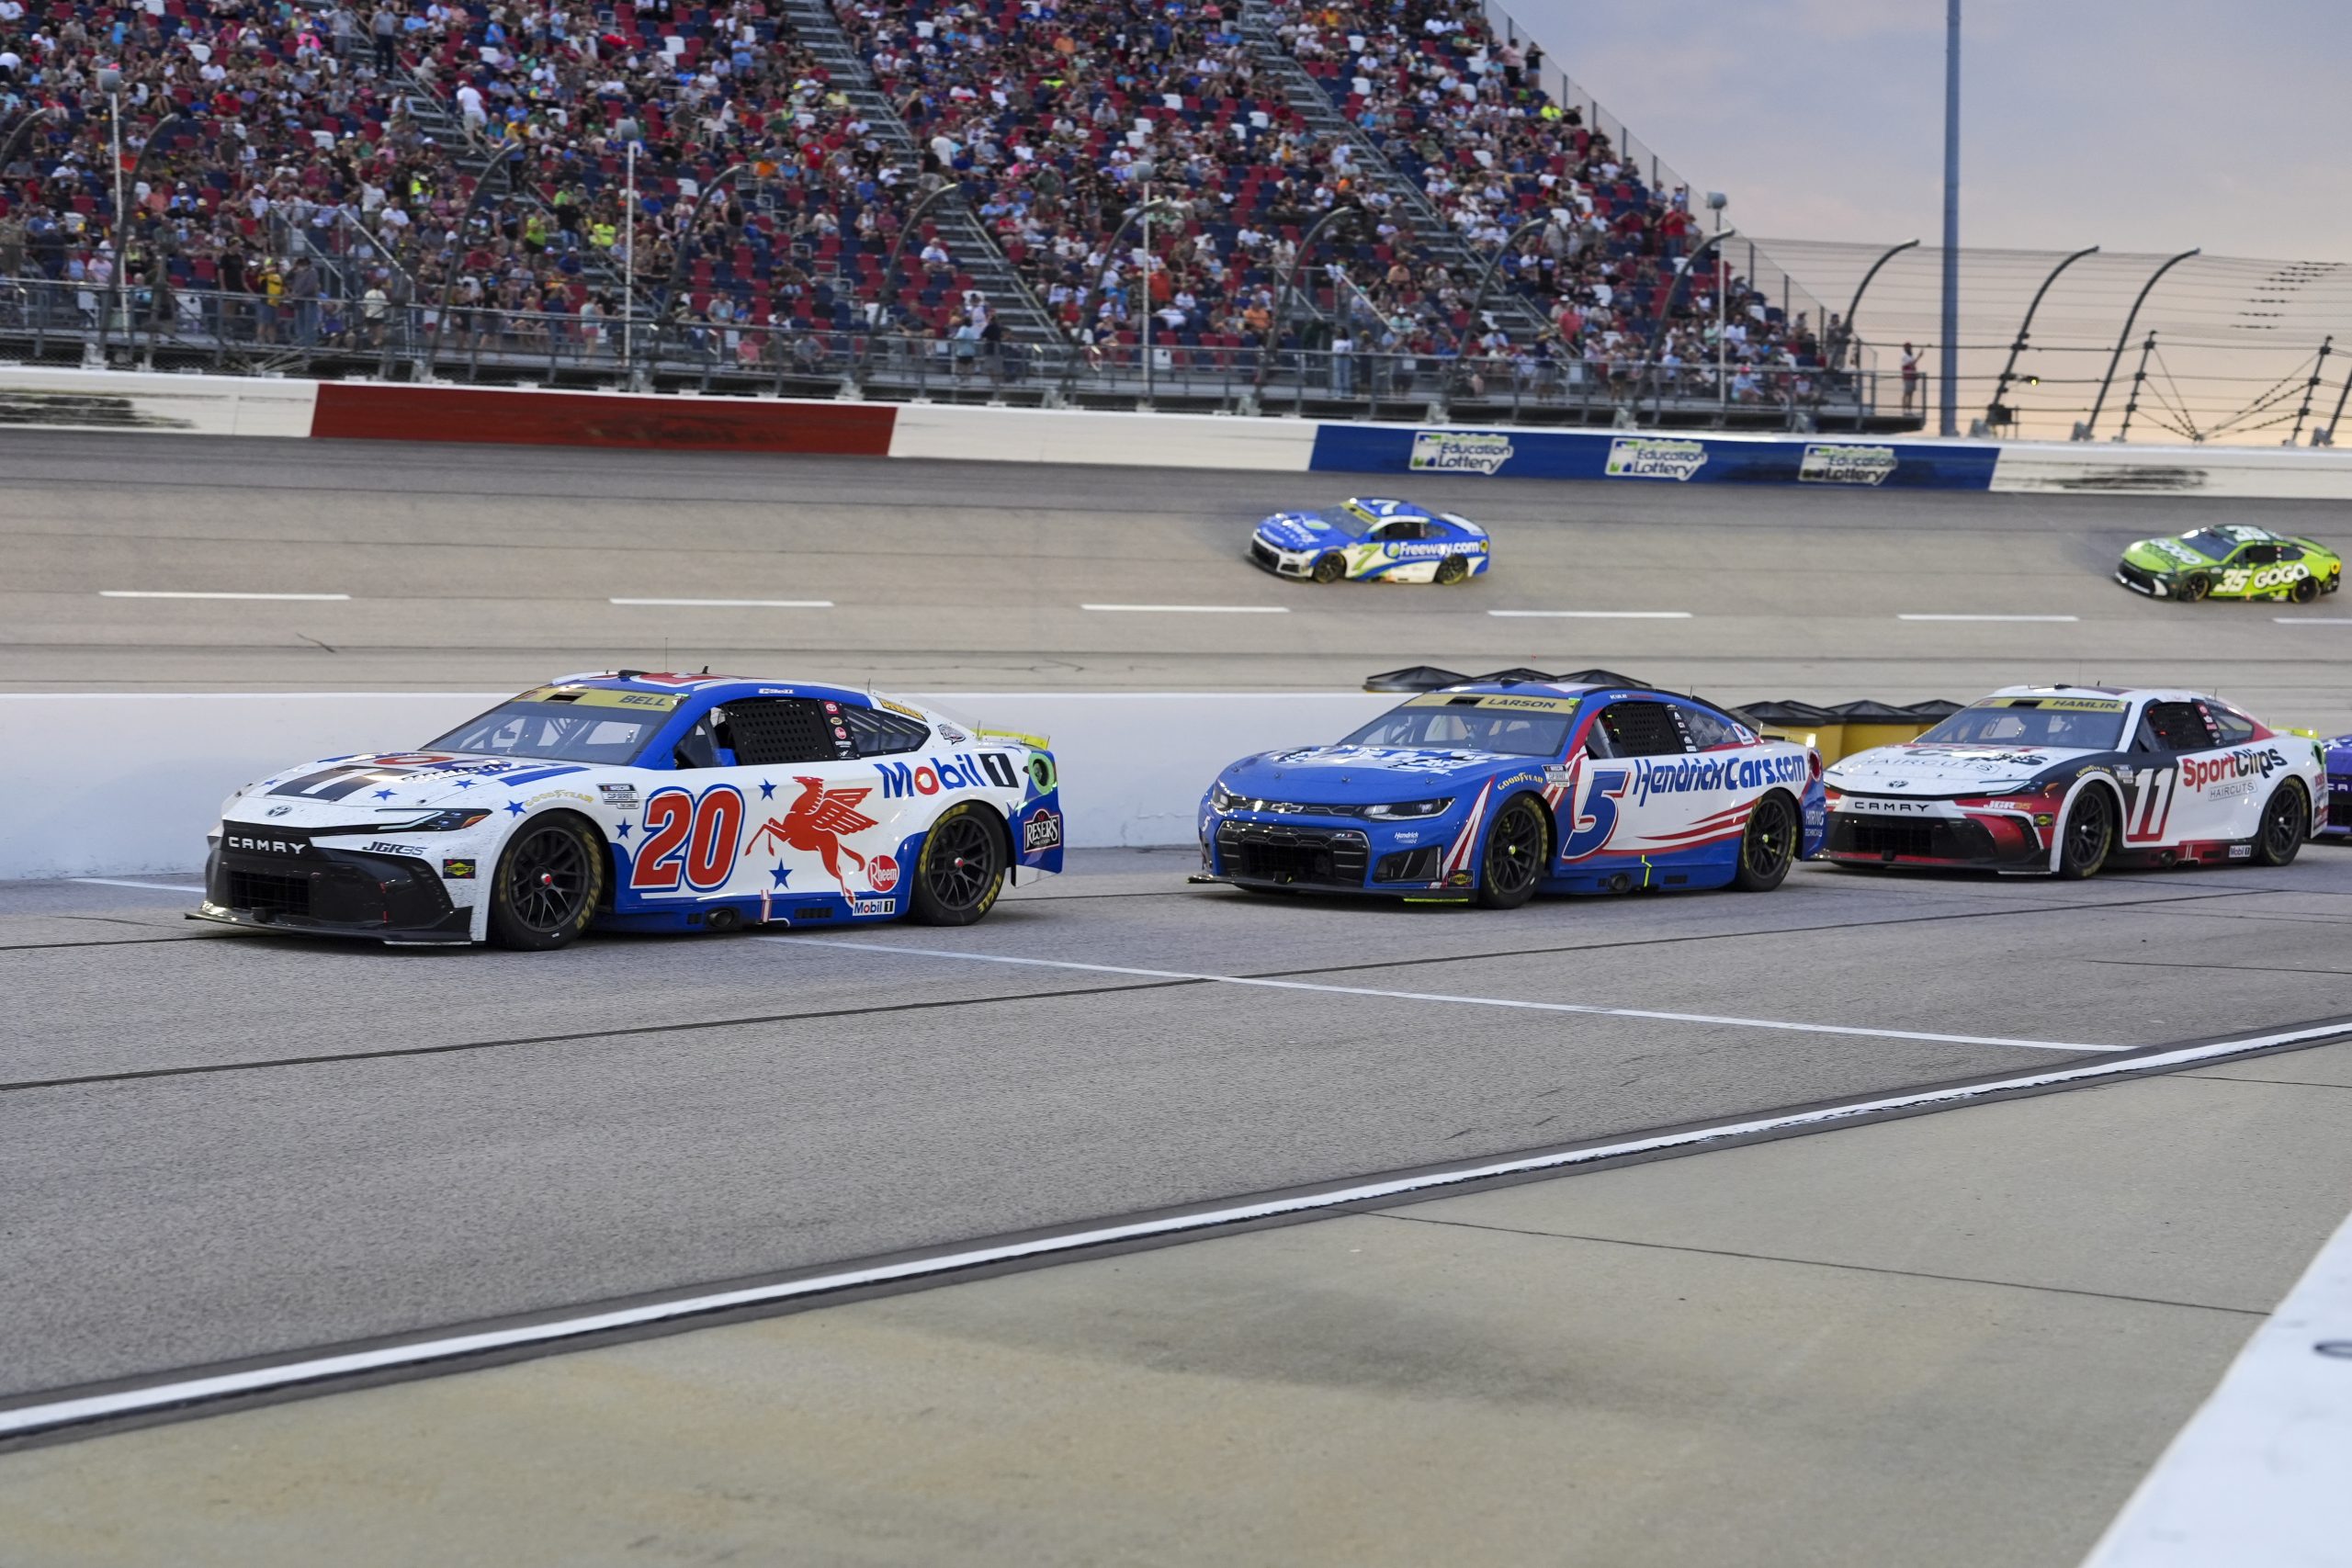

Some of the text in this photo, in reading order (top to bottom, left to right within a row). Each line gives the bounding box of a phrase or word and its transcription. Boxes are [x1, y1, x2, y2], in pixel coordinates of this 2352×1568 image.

[1438, 457, 1501, 471] Lottery
[1634, 461, 1695, 477] Lottery
[1352, 542, 1385, 571] 7
[1400, 542, 1479, 558] Freeway.com
[2212, 569, 2253, 592] 35
[2253, 562, 2310, 589] GOGO
[618, 694, 666, 706] BELL
[1487, 698, 1557, 709] LARSON
[2052, 700, 2118, 709] HAMLIN
[874, 753, 1015, 799] Mobil 1
[2182, 749, 2289, 793] SportClips
[1497, 772, 1544, 791] GOODYEAR
[1633, 755, 1806, 807] HendrickCars.com
[524, 789, 594, 807] GOODYEAR
[2210, 782, 2256, 799] HAIRCUTS
[1854, 801, 1930, 812] CAMRY
[2127, 768, 2176, 836] 11
[1563, 769, 1631, 863] 5
[632, 786, 745, 891] 20
[1394, 831, 1419, 840] Hendrick
[228, 836, 307, 854] CAMRY
[2230, 846, 2244, 857] Mobil
[869, 855, 898, 887] Rheem
[854, 901, 882, 915] Mobil
